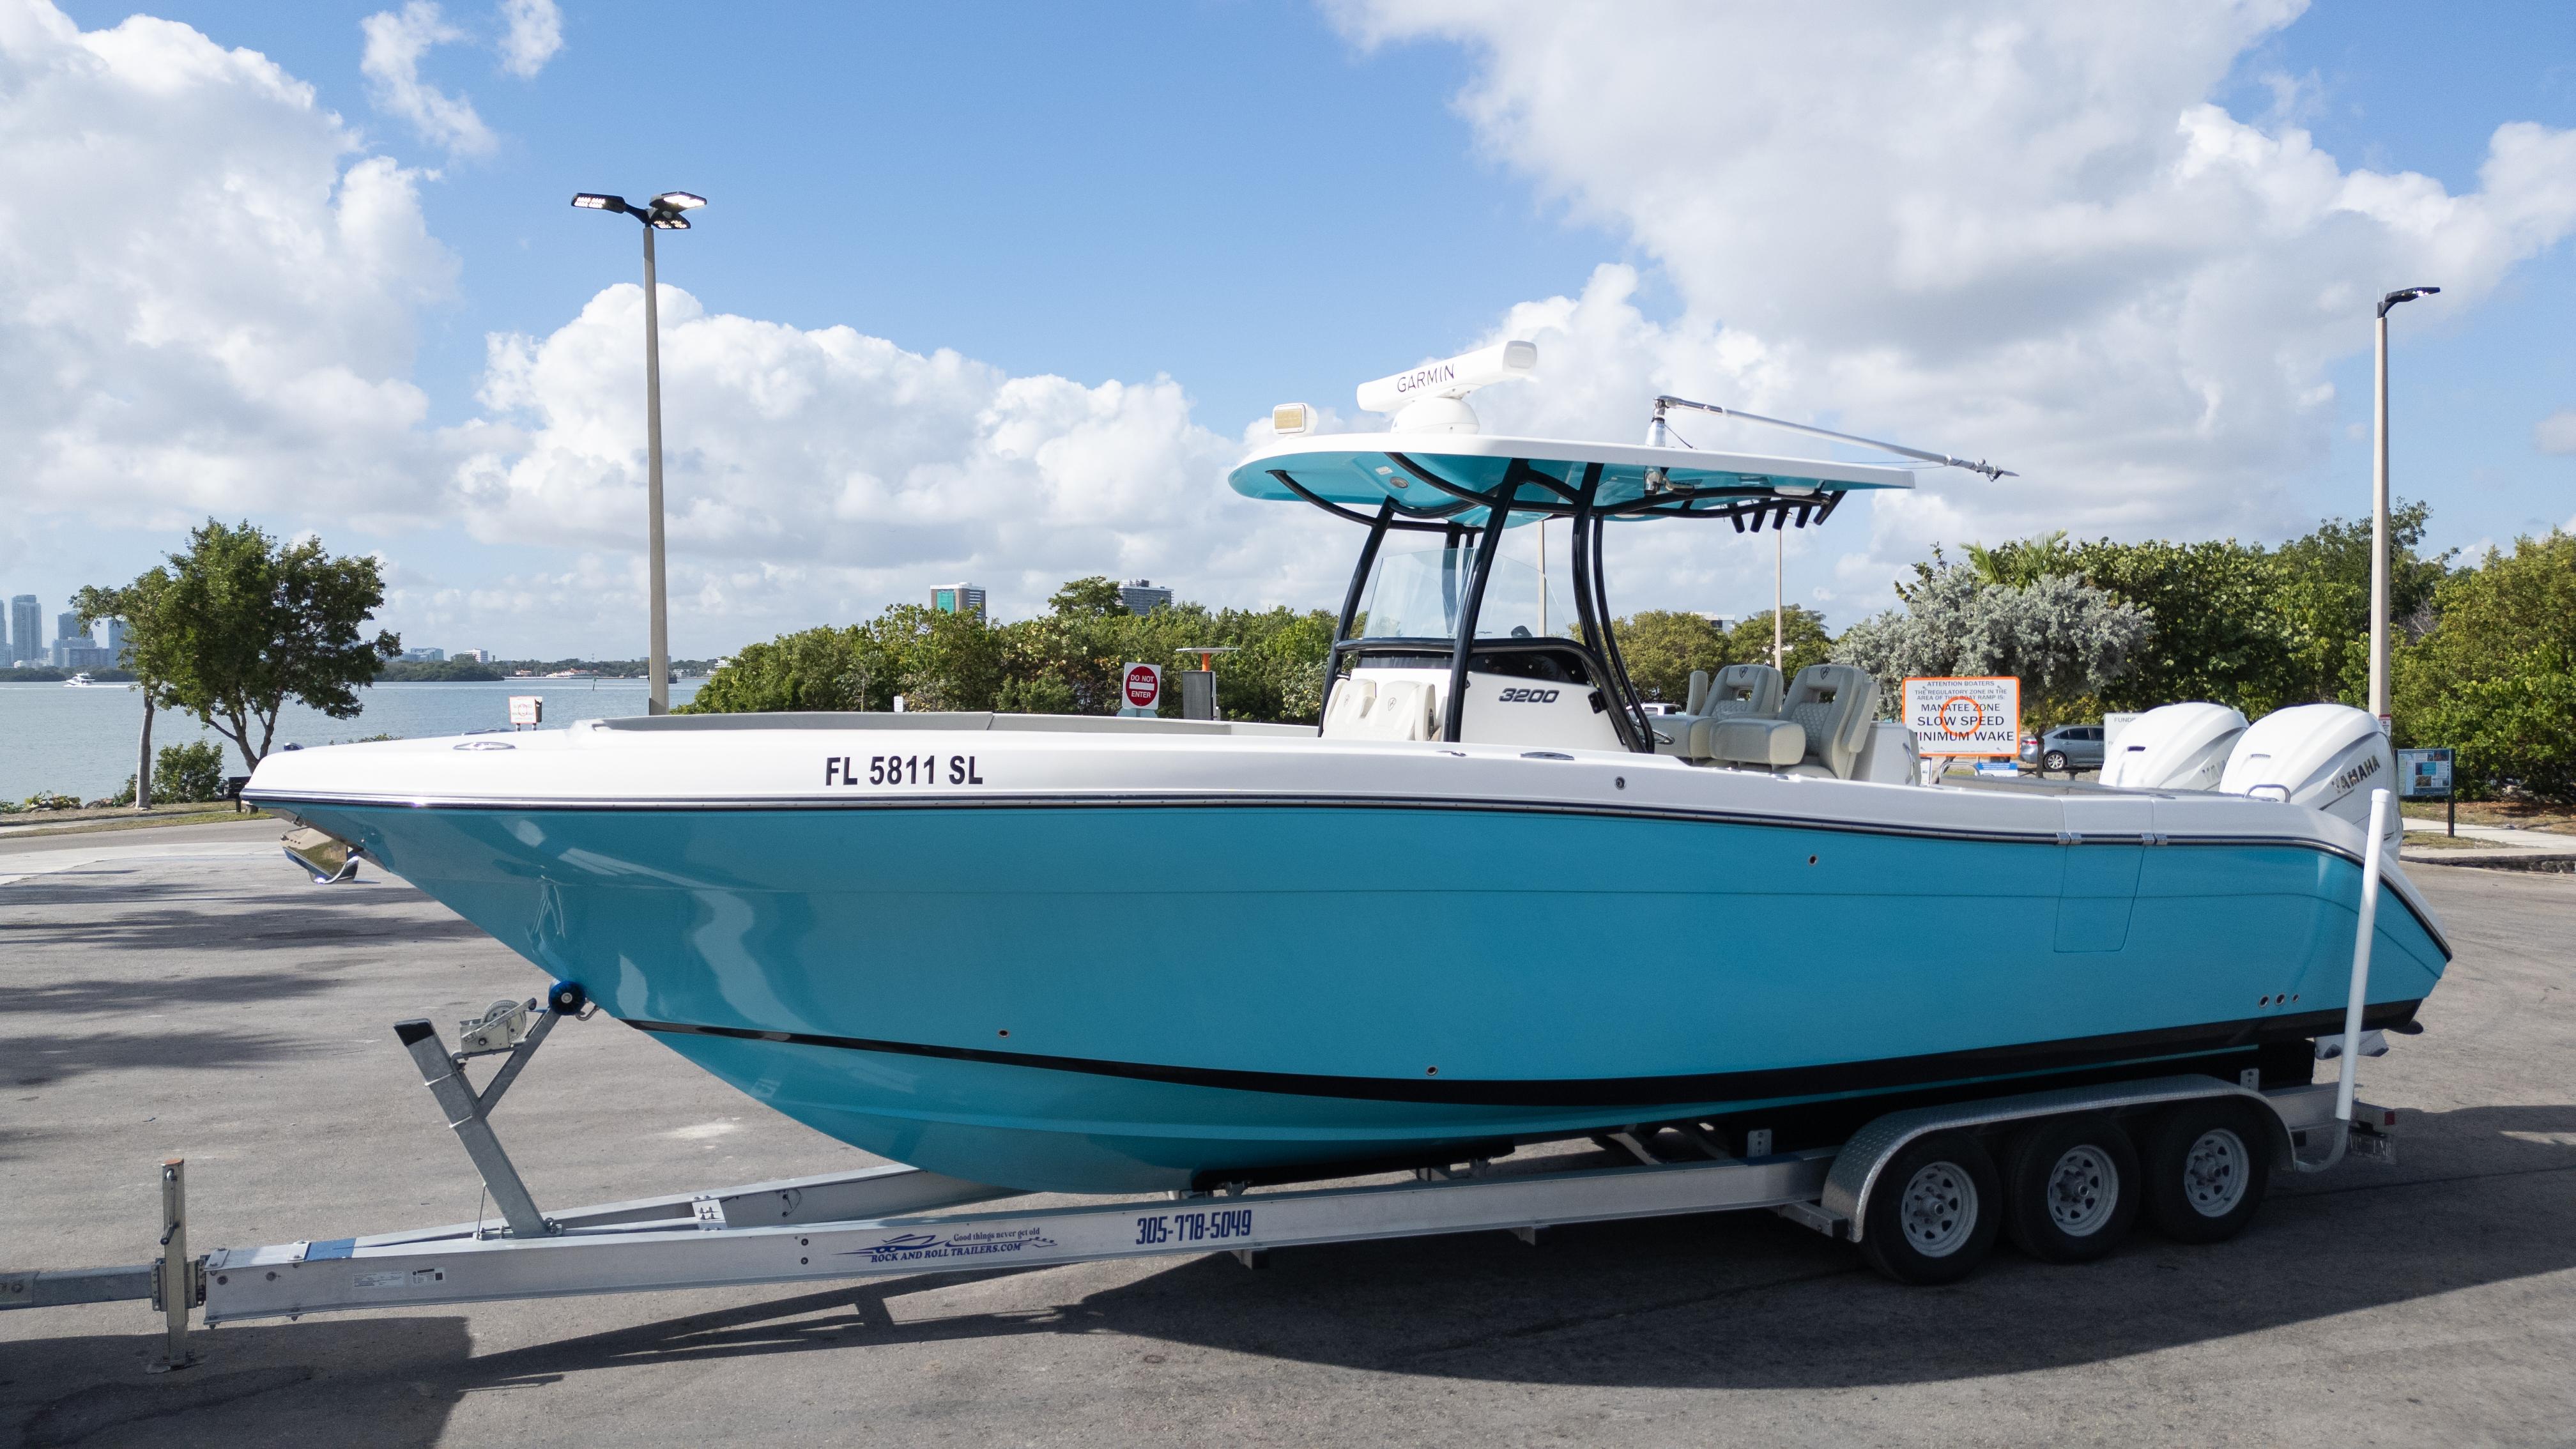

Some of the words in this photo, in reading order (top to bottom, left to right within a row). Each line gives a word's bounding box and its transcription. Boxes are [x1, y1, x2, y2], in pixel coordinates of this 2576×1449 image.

[1397, 364, 1455, 392] GARMIN
[1498, 687, 1560, 703] 3200
[1921, 703, 1970, 712] MANATEE
[1917, 716, 1956, 726] SLOW
[1961, 716, 2004, 726] SPEED
[1974, 732, 2014, 741] WAKE
[825, 756, 858, 786] FL
[869, 755, 935, 785] 5811
[949, 755, 983, 785] SL
[2331, 755, 2381, 794] YAMAHA
[953, 1233, 972, 1242] Good
[973, 1231, 995, 1242] things
[1017, 1229, 1028, 1238] get
[1029, 1227, 1040, 1236] old
[1135, 1209, 1252, 1245] 305-778-5049
[870, 1252, 898, 1263] ROCK
[900, 1251, 923, 1261] AND
[924, 1248, 949, 1258] ROLL
[951, 1243, 1021, 1256] TRAILERS.COM
